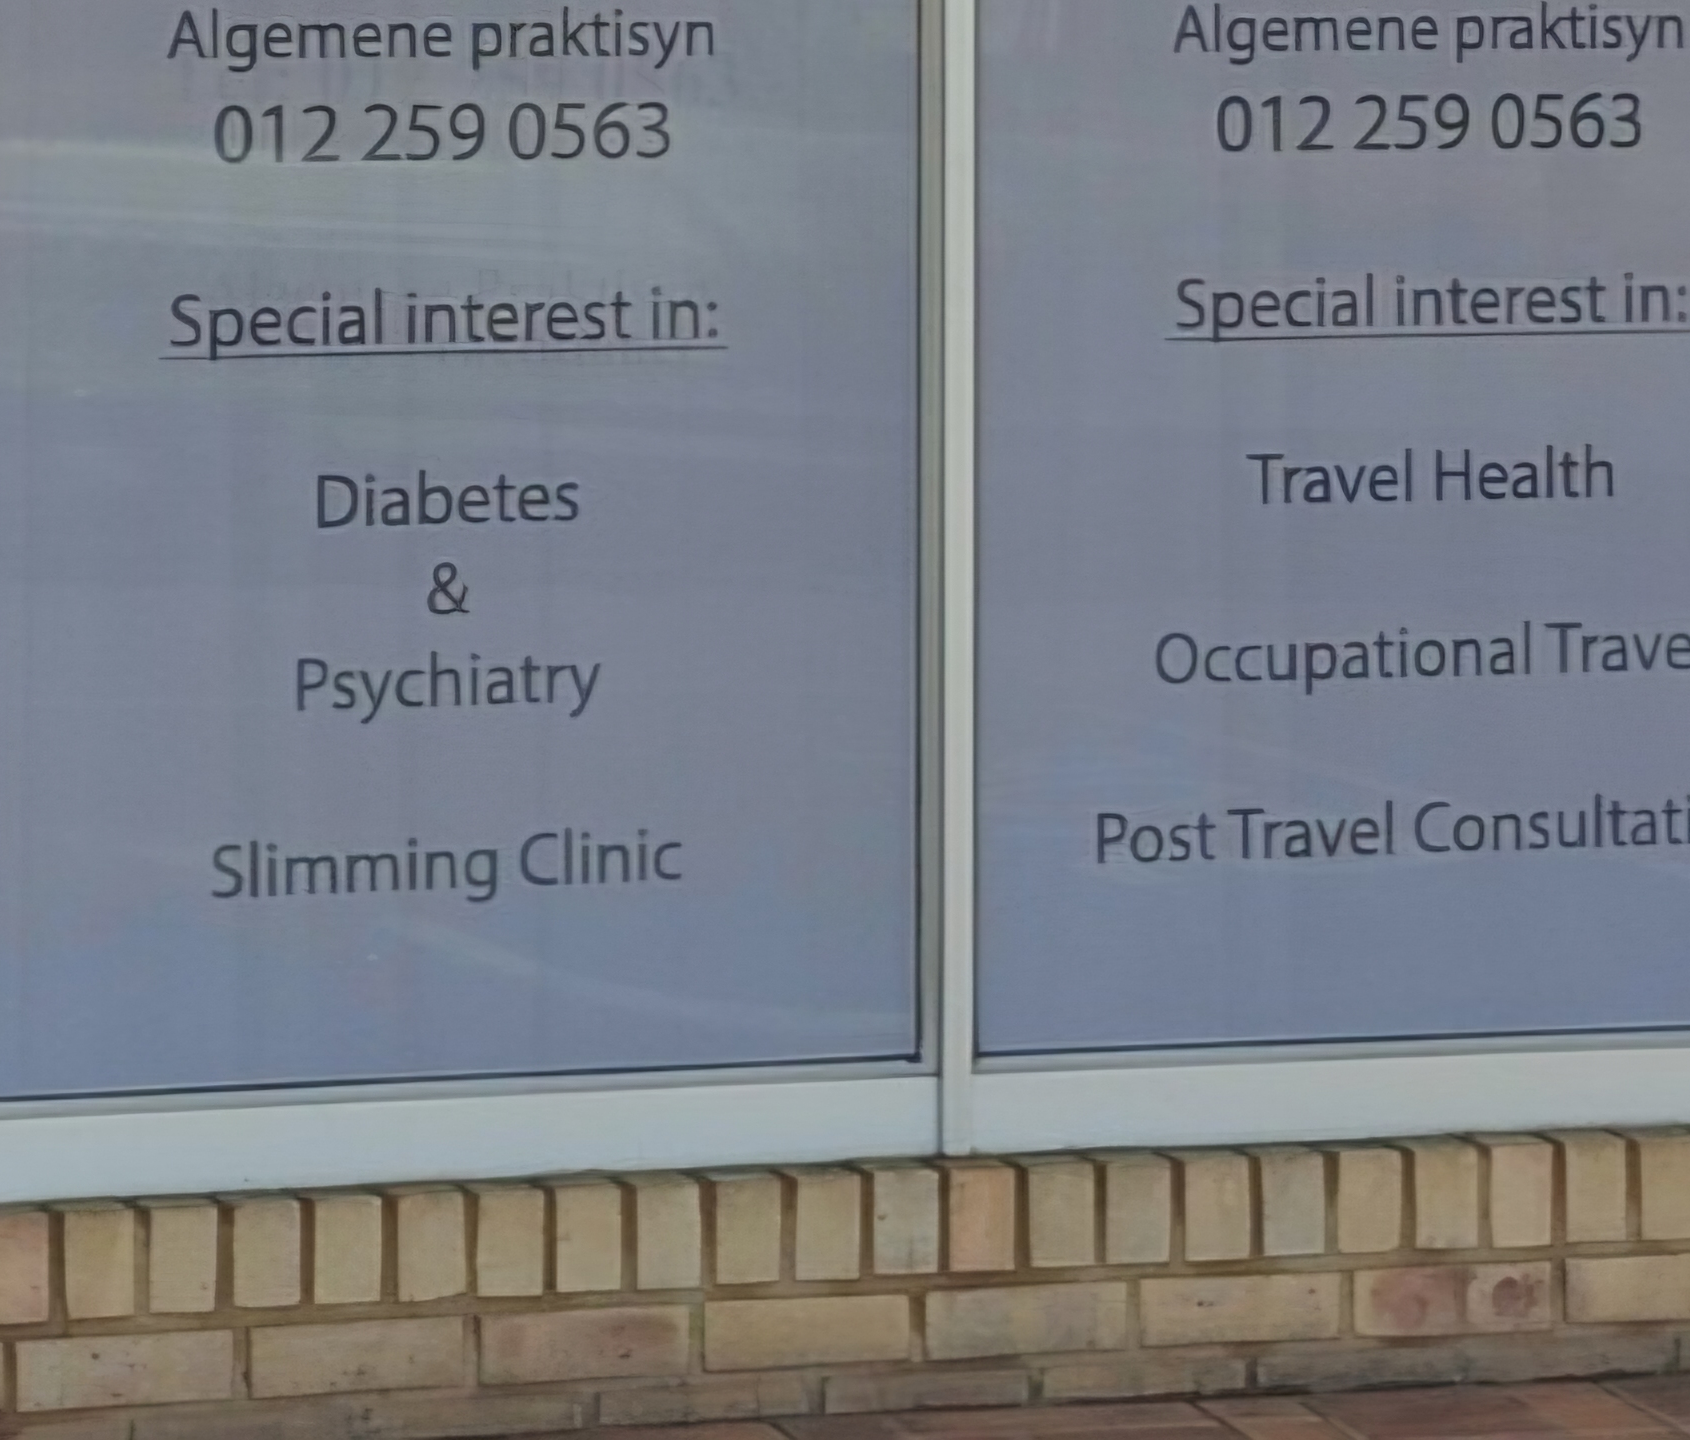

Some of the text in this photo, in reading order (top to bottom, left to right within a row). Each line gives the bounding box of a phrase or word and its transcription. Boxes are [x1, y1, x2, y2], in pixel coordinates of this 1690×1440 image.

[168, 5, 716, 72] Algemene praktisyn
[1173, 1, 1686, 66] Algemene praktisyn
[213, 101, 673, 165] 012 259 0563
[1216, 93, 1644, 154] 012 259 0563
[170, 287, 719, 361] Special interest in:
[1175, 273, 1688, 343] Special interest in:
[315, 470, 582, 529] Diabetes
[1246, 444, 1616, 506] Travel Health
[426, 561, 471, 616] &
[295, 651, 603, 724] Psychiatry
[1154, 620, 1532, 695] Occupational
[211, 826, 685, 903] Slimming Clinic
[1095, 811, 1217, 865] Post
[1228, 800, 1396, 862] Travel
